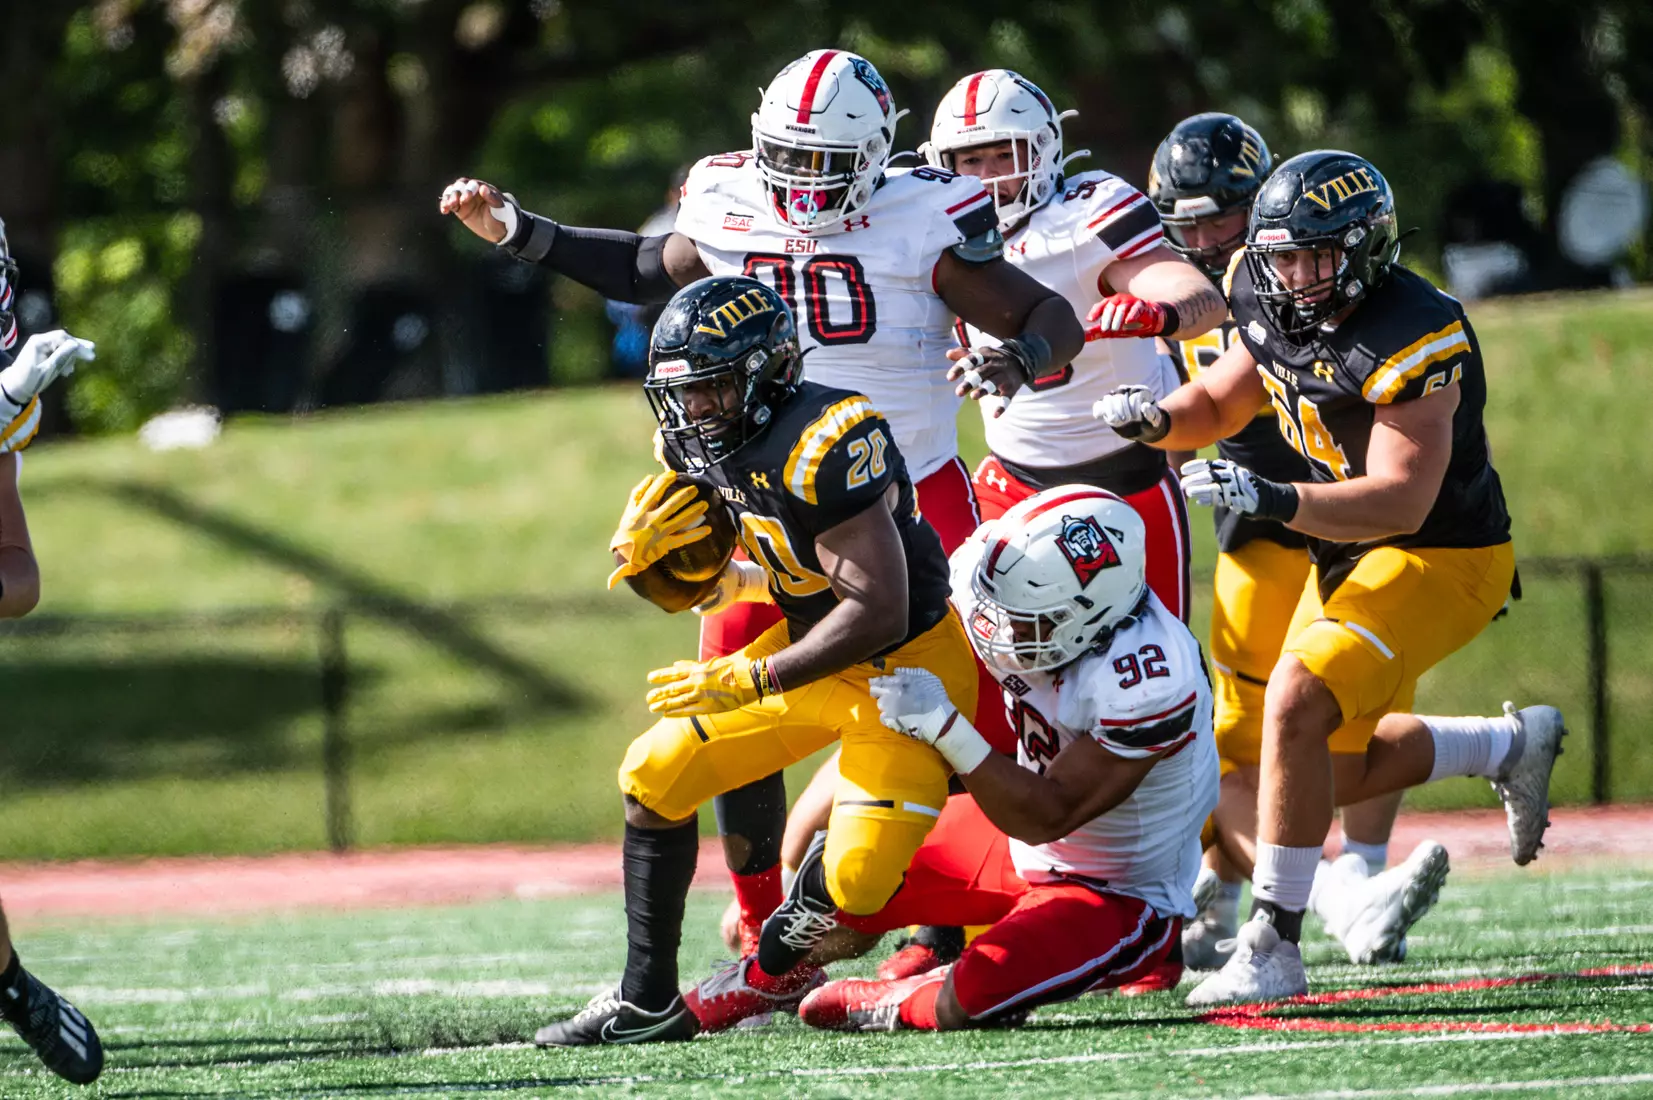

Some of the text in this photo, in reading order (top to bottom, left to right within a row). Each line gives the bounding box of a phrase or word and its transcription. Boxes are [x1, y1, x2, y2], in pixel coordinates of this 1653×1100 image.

[1303, 167, 1379, 211] VILLE
[724, 216, 753, 228] PSAC
[784, 238, 819, 254] ESU
[693, 288, 775, 338] VILLE
[846, 428, 888, 490] 20
[1002, 674, 1032, 697] ESU
[1113, 644, 1170, 690] 92
